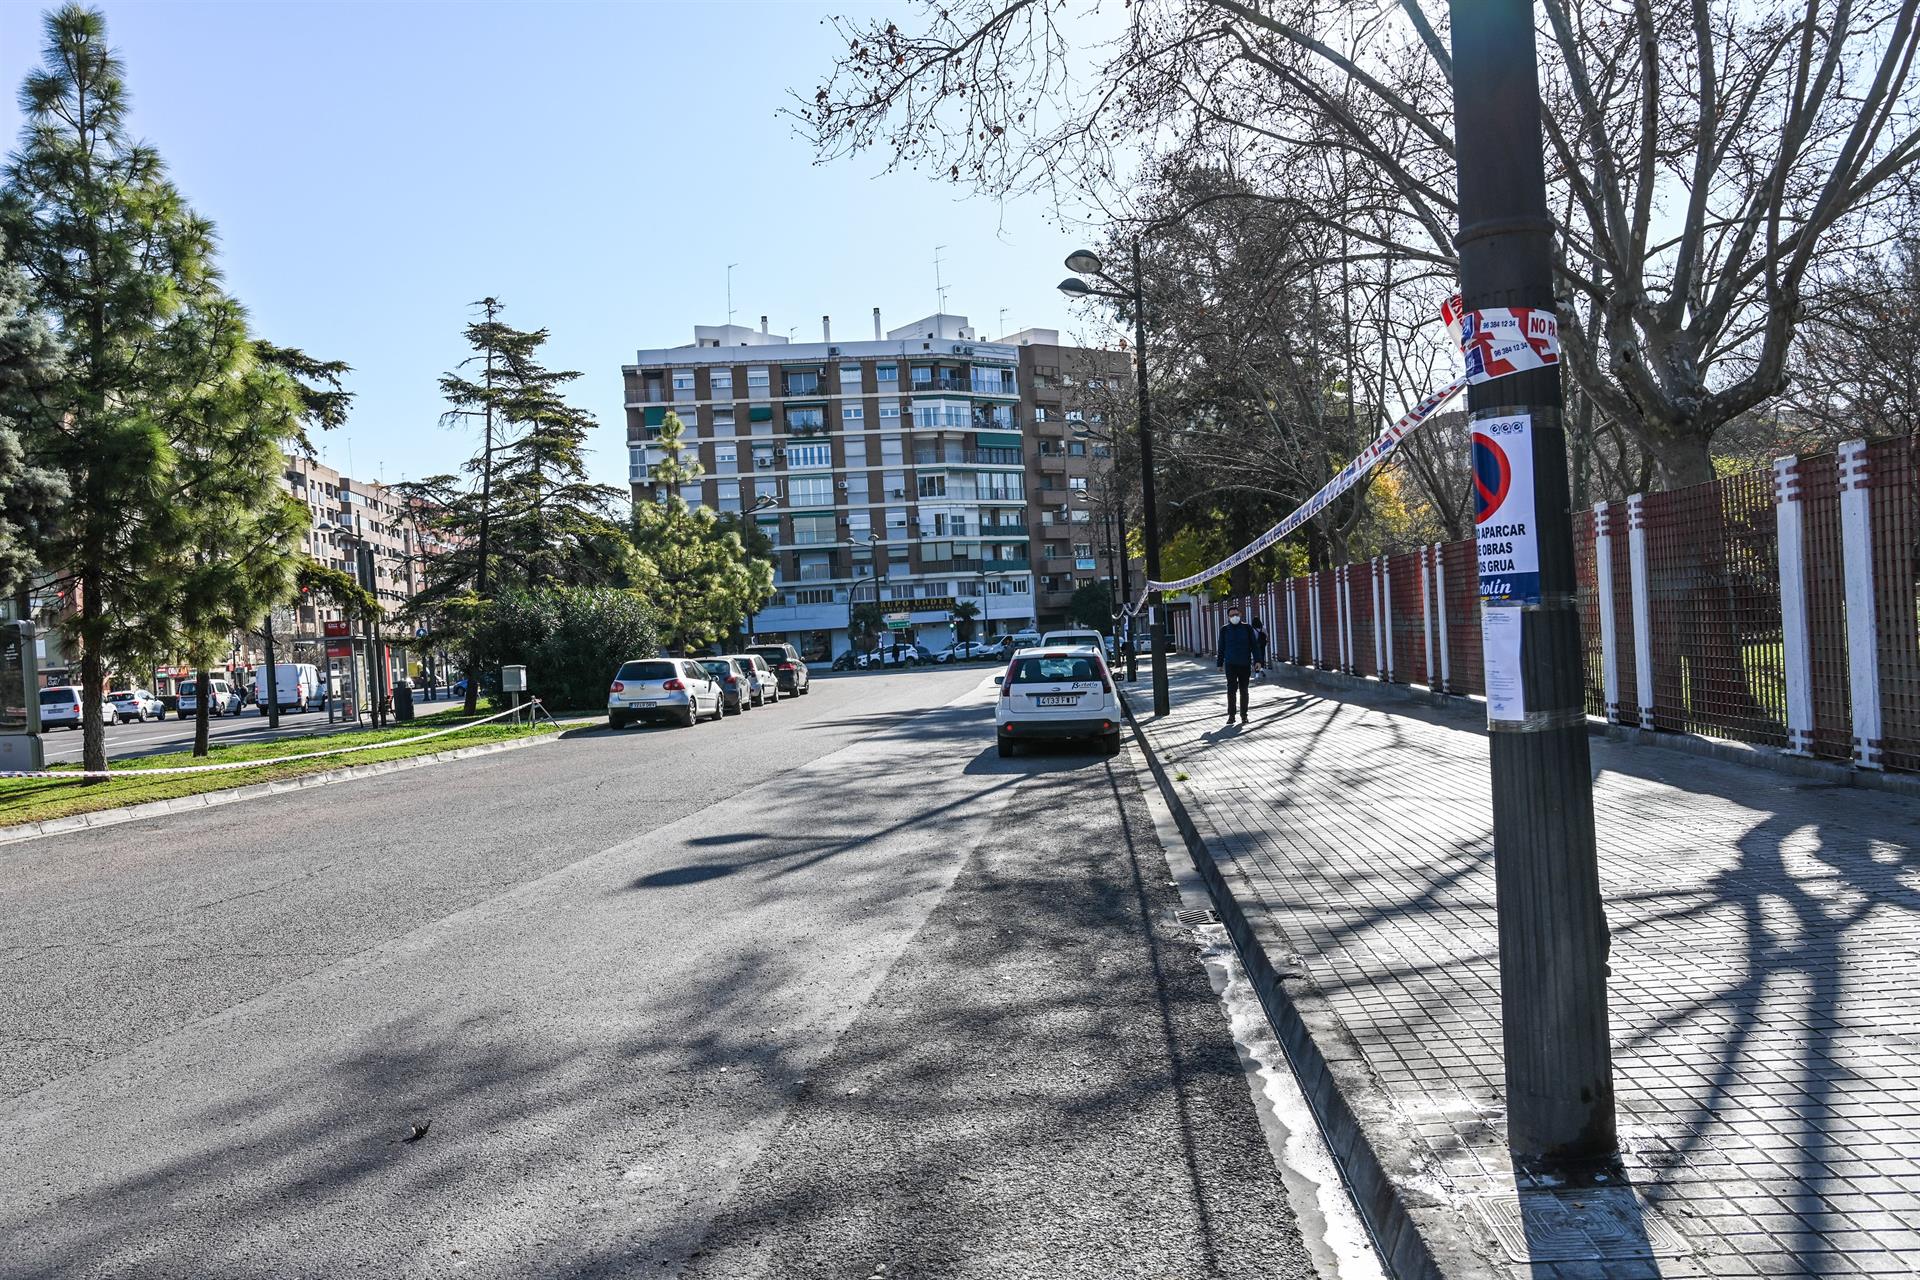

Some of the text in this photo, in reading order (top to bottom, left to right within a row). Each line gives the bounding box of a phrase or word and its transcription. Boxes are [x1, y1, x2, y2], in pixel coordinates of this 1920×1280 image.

[1530, 317, 1546, 335] NO
[1501, 347, 1512, 355] 384
[1481, 523, 1526, 539] APARCAR
[1482, 541, 1513, 556] OBRAS
[1487, 558, 1516, 573] GRUA
